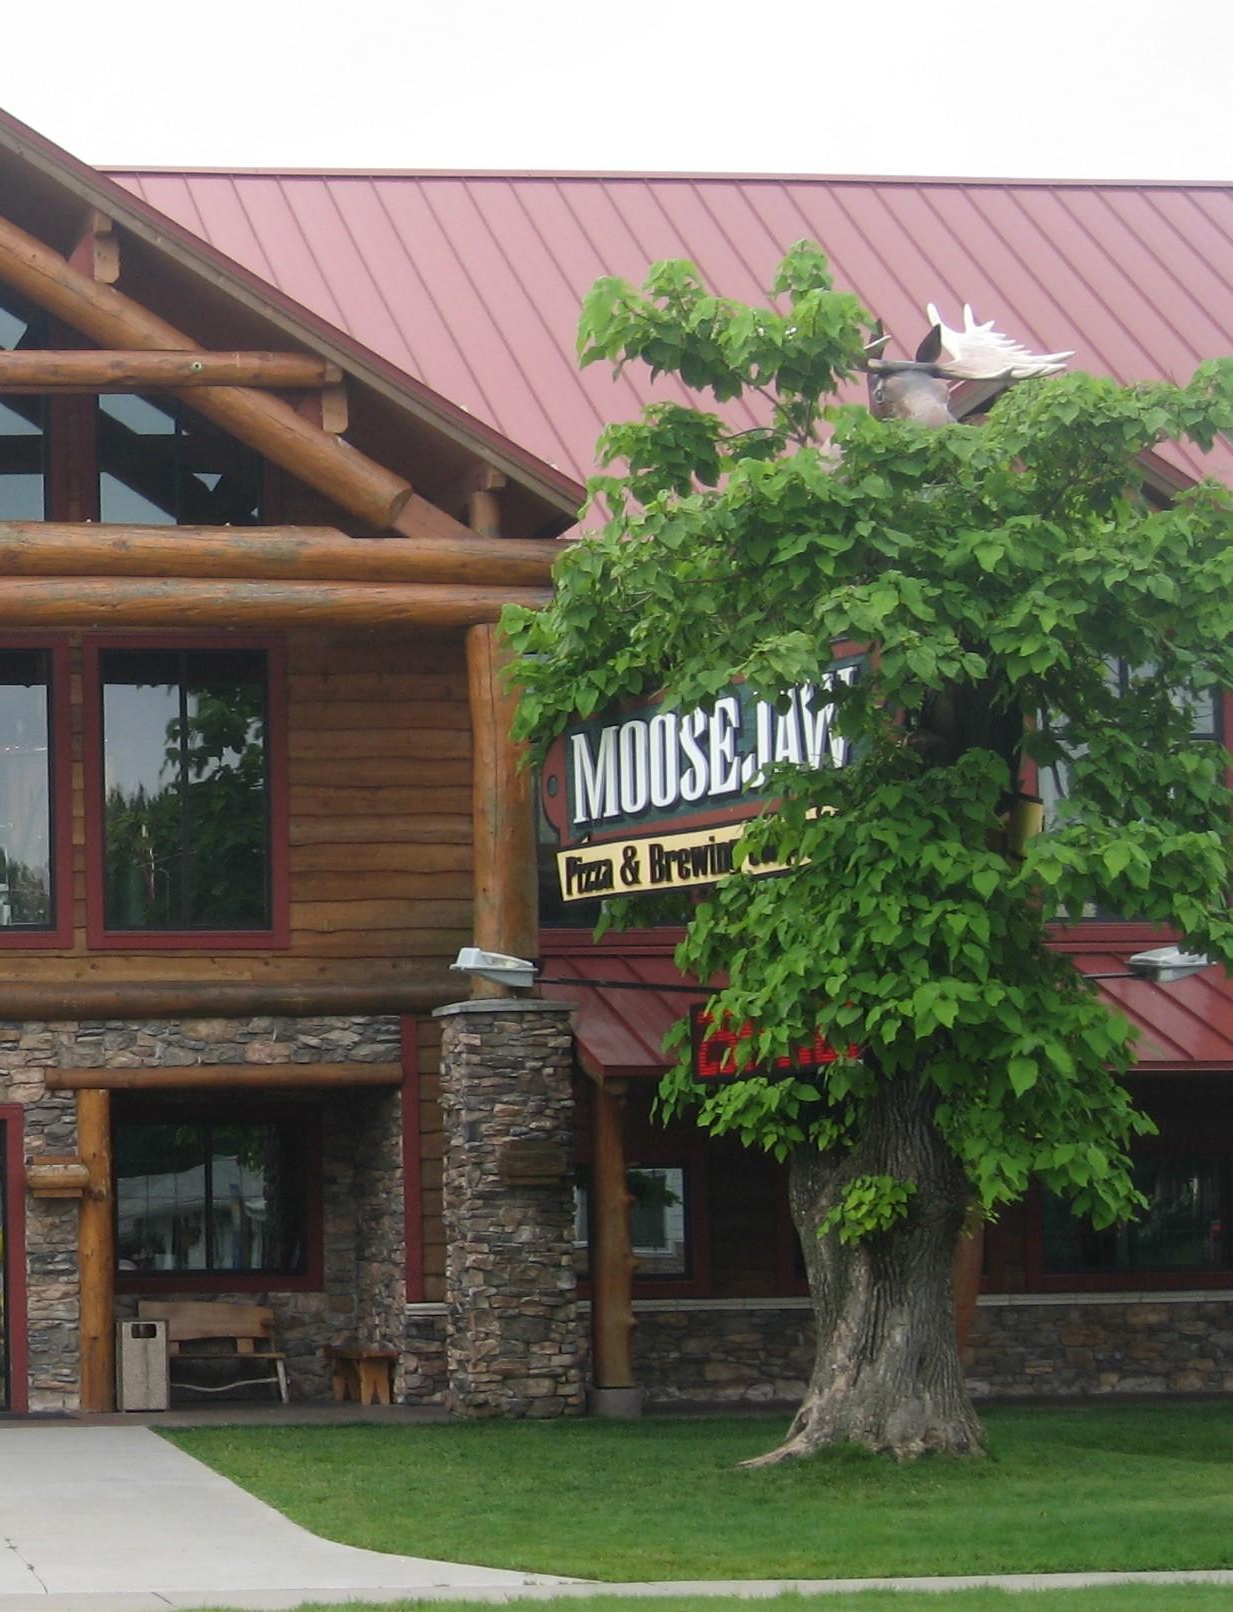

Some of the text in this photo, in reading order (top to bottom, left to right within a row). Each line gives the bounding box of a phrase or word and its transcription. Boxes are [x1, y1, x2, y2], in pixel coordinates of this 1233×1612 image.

[570, 697, 741, 824] MOOSE
[566, 855, 614, 896] Pizza
[620, 845, 641, 886] &
[649, 835, 741, 884] Brewin
